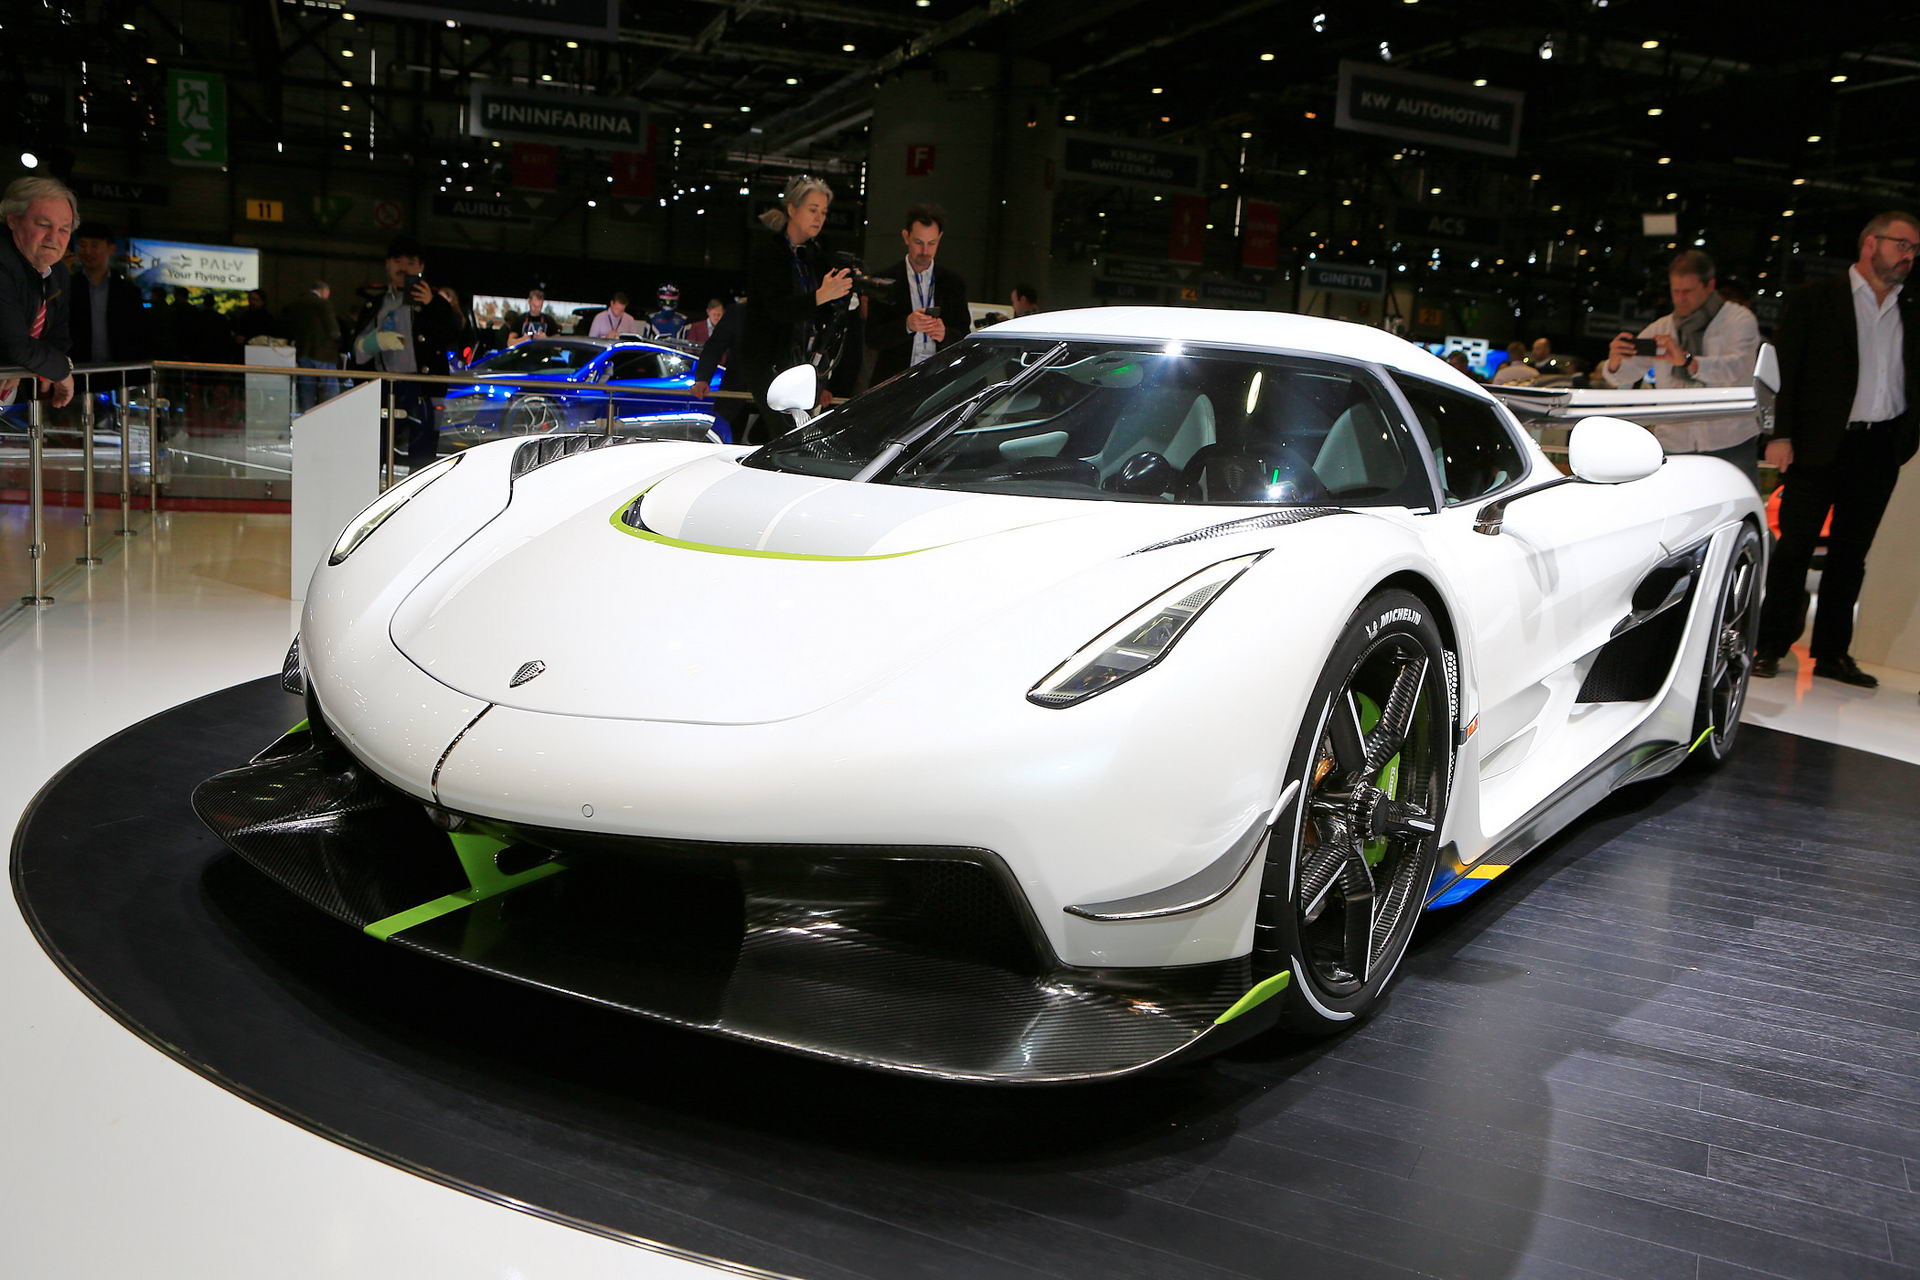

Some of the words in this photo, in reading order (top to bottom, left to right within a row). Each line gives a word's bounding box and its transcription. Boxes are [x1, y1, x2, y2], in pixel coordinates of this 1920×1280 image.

[487, 102, 632, 134] PININFARINA
[1360, 91, 1391, 110] KW
[1395, 97, 1501, 130] AUTOMOTIVE
[914, 147, 928, 168] F
[1091, 159, 1174, 179] SWITZERLAND
[258, 200, 271, 218] 11
[453, 200, 513, 218] AURUS
[169, 269, 191, 281] Your
[195, 270, 226, 284] Flying
[228, 273, 246, 284] Car
[1319, 272, 1373, 288] GINETTA
[1380, 607, 1422, 630] MICHELIN
